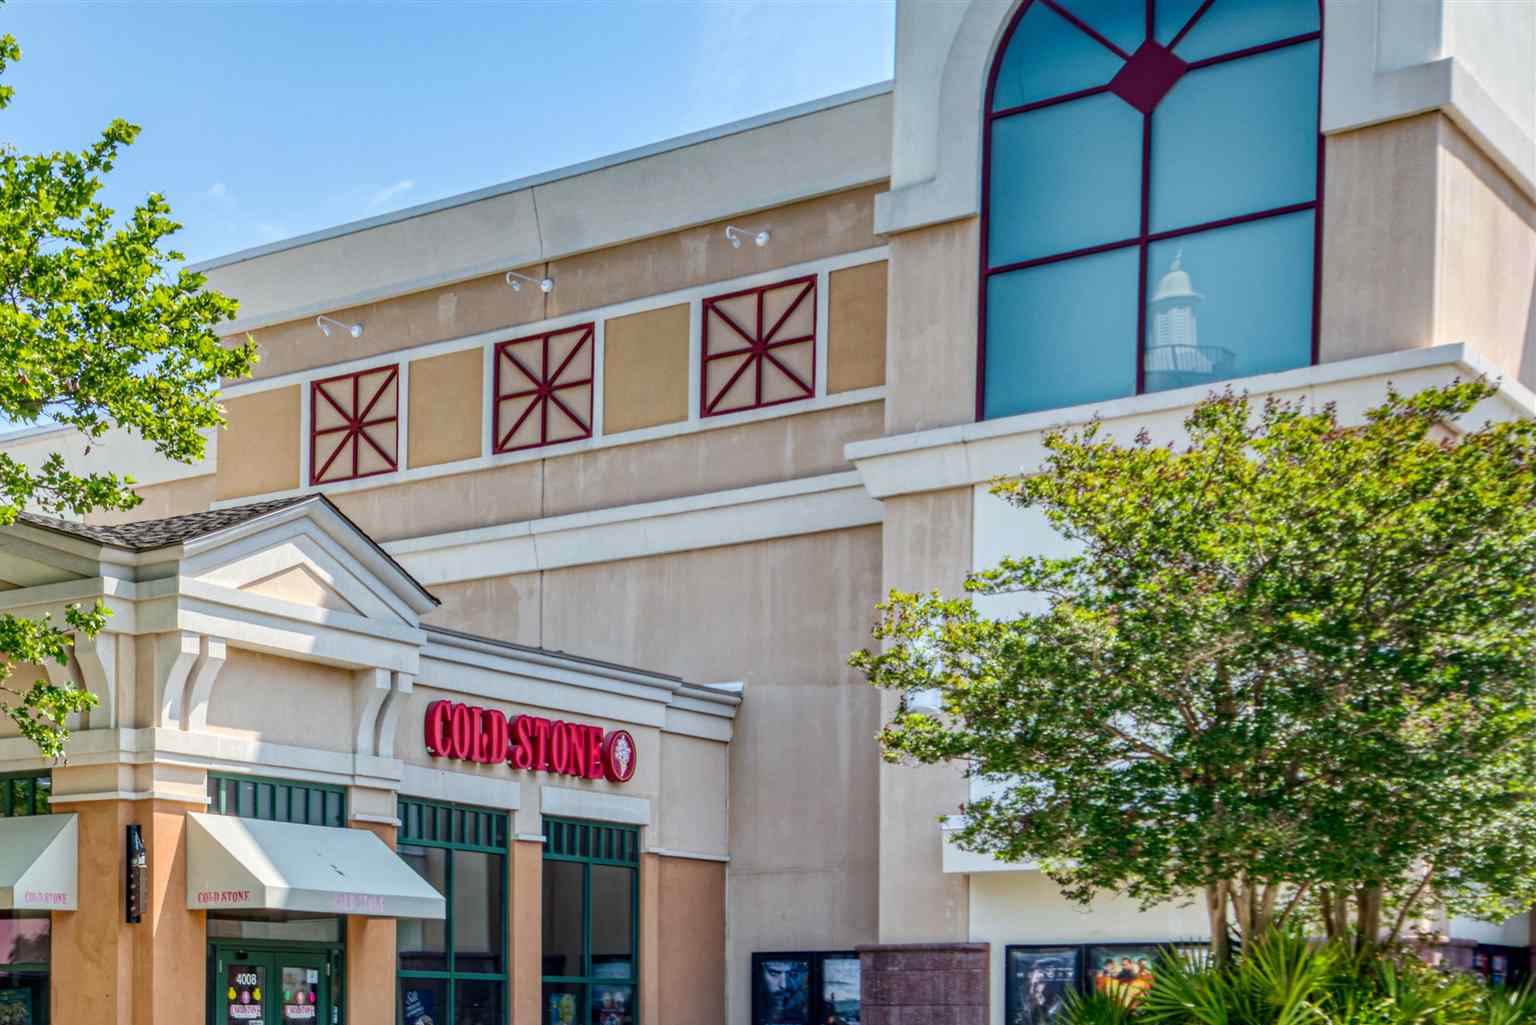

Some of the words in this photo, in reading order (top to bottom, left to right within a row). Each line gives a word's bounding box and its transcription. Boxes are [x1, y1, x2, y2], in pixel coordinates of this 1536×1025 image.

[424, 700, 509, 765] COLD
[509, 713, 606, 781] STONE
[198, 891, 220, 904] COLD
[220, 890, 251, 904] STONE
[236, 974, 257, 985] 4008
